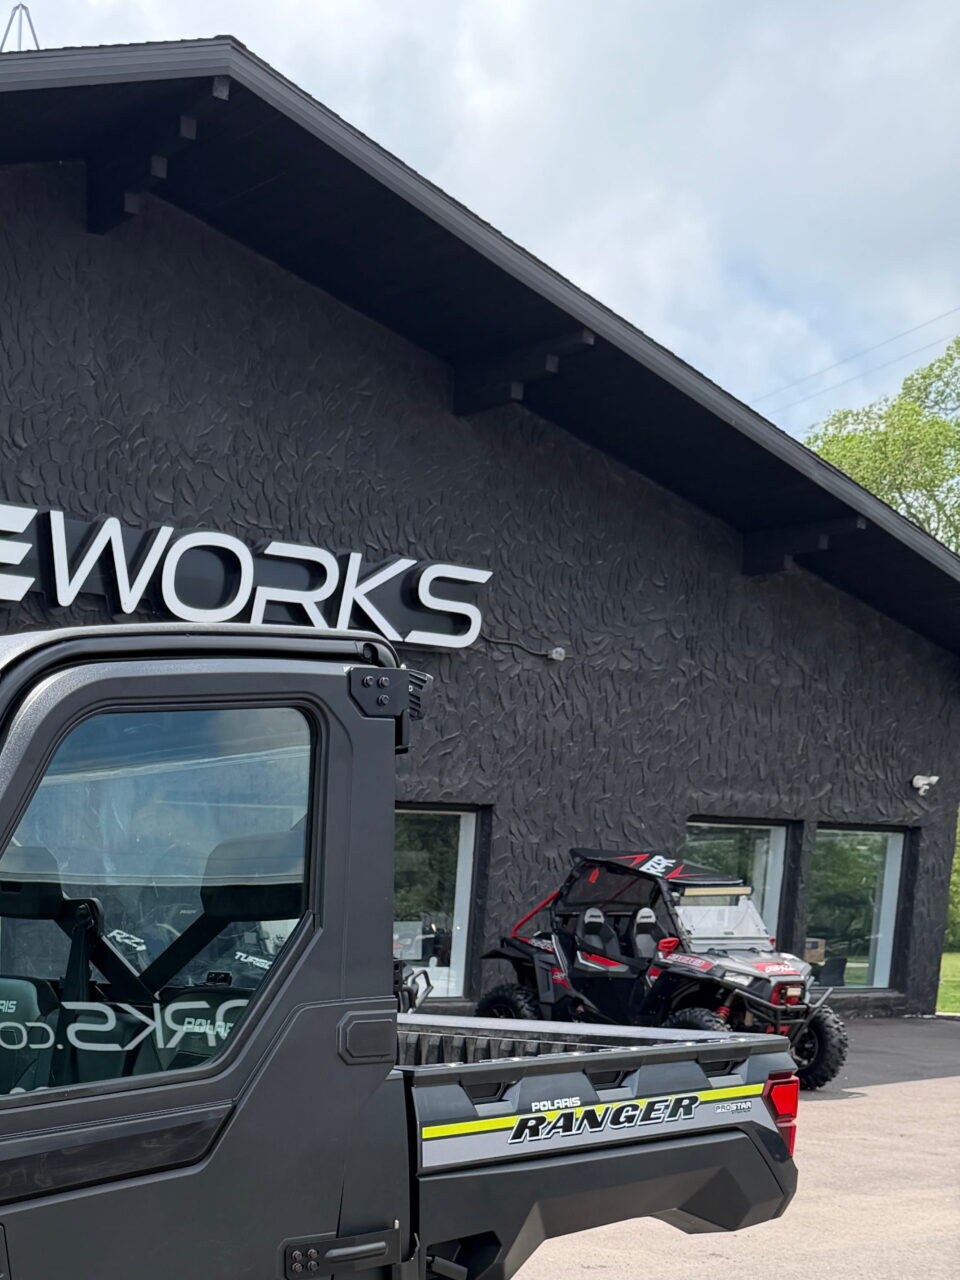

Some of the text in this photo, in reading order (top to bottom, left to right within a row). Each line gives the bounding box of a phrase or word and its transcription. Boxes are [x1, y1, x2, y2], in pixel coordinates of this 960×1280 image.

[639, 855, 676, 876] RZR
[531, 1096, 581, 1112] POLARIS
[507, 1095, 701, 1144] RANGER
